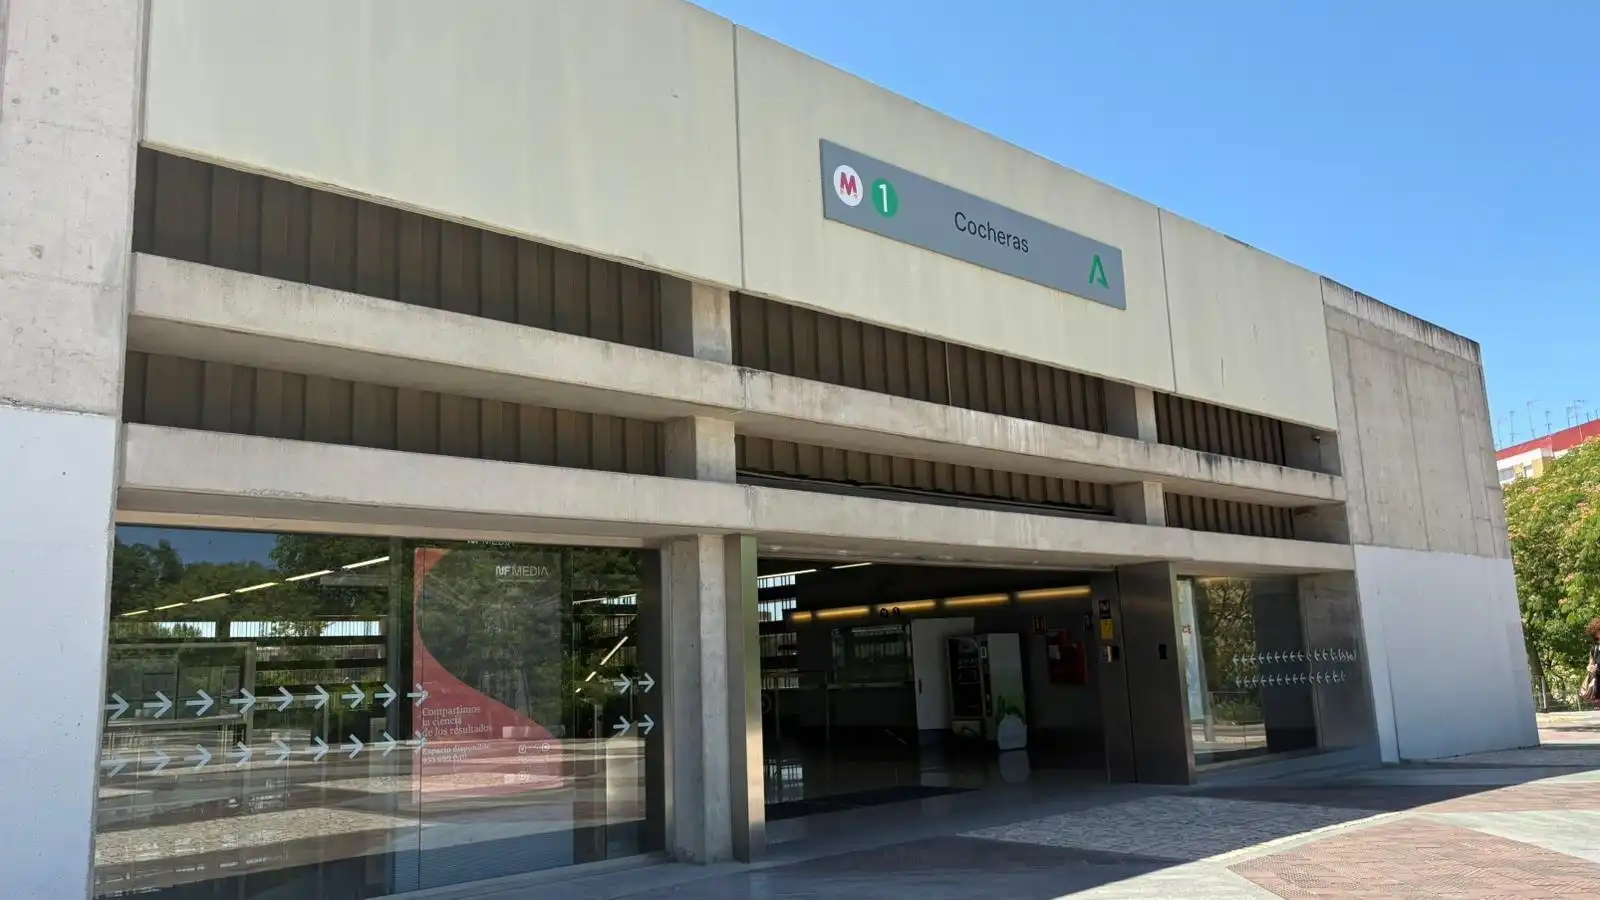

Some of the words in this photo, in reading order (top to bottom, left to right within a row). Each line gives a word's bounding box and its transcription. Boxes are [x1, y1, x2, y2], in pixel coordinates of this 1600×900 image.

[840, 170, 858, 196] M
[879, 183, 889, 213] 1
[954, 210, 1030, 254] Cocheras
[422, 705, 481, 717] Compartimos
[422, 716, 431, 726] la
[432, 716, 462, 726] ciencia
[422, 727, 433, 737] de
[435, 726, 448, 737] los
